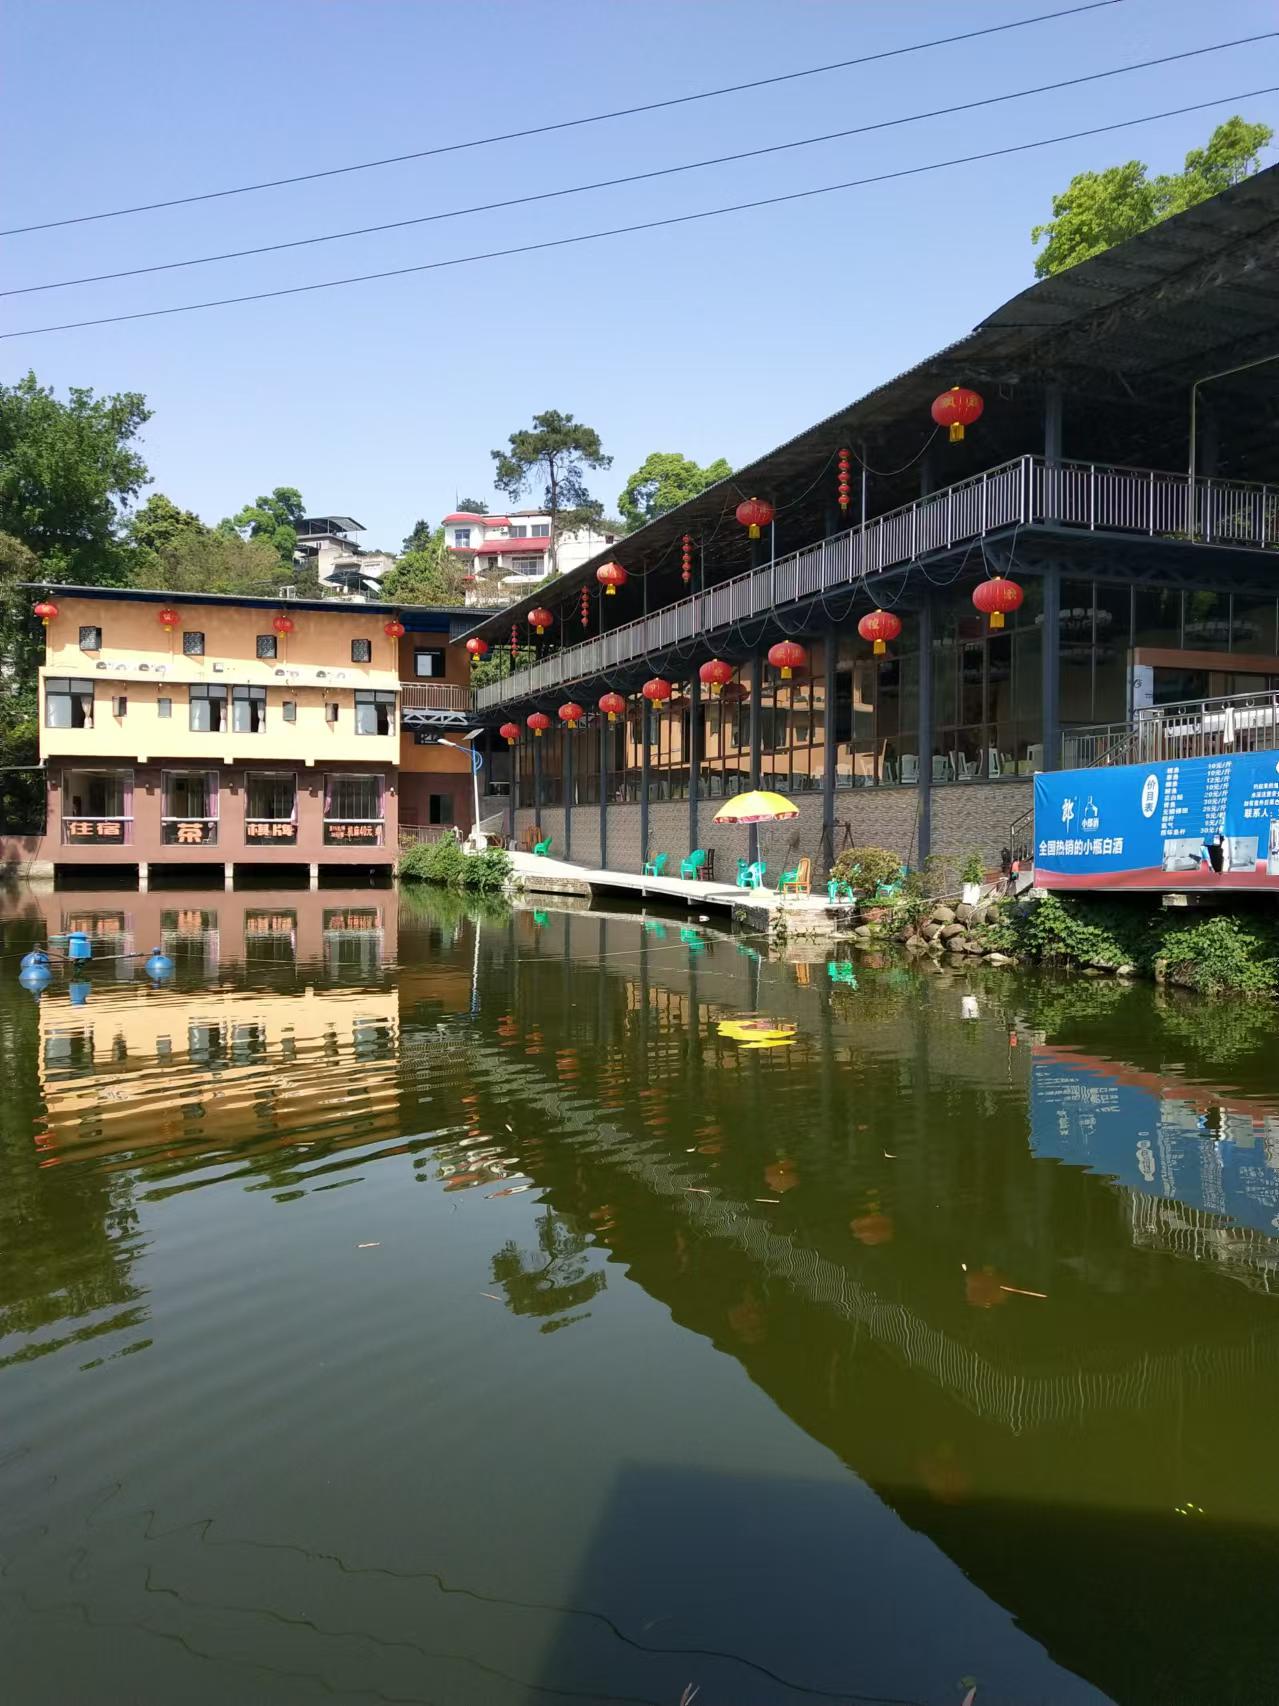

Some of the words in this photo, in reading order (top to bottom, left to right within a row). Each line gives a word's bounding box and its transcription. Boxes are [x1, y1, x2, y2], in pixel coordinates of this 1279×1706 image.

[1144, 779, 1156, 812] 价目表
[69, 822, 120, 836] 住宿
[176, 823, 203, 843] 茶
[247, 823, 296, 837] 棋牌
[1039, 837, 1124, 856] 全国热销的小瓶白酒
